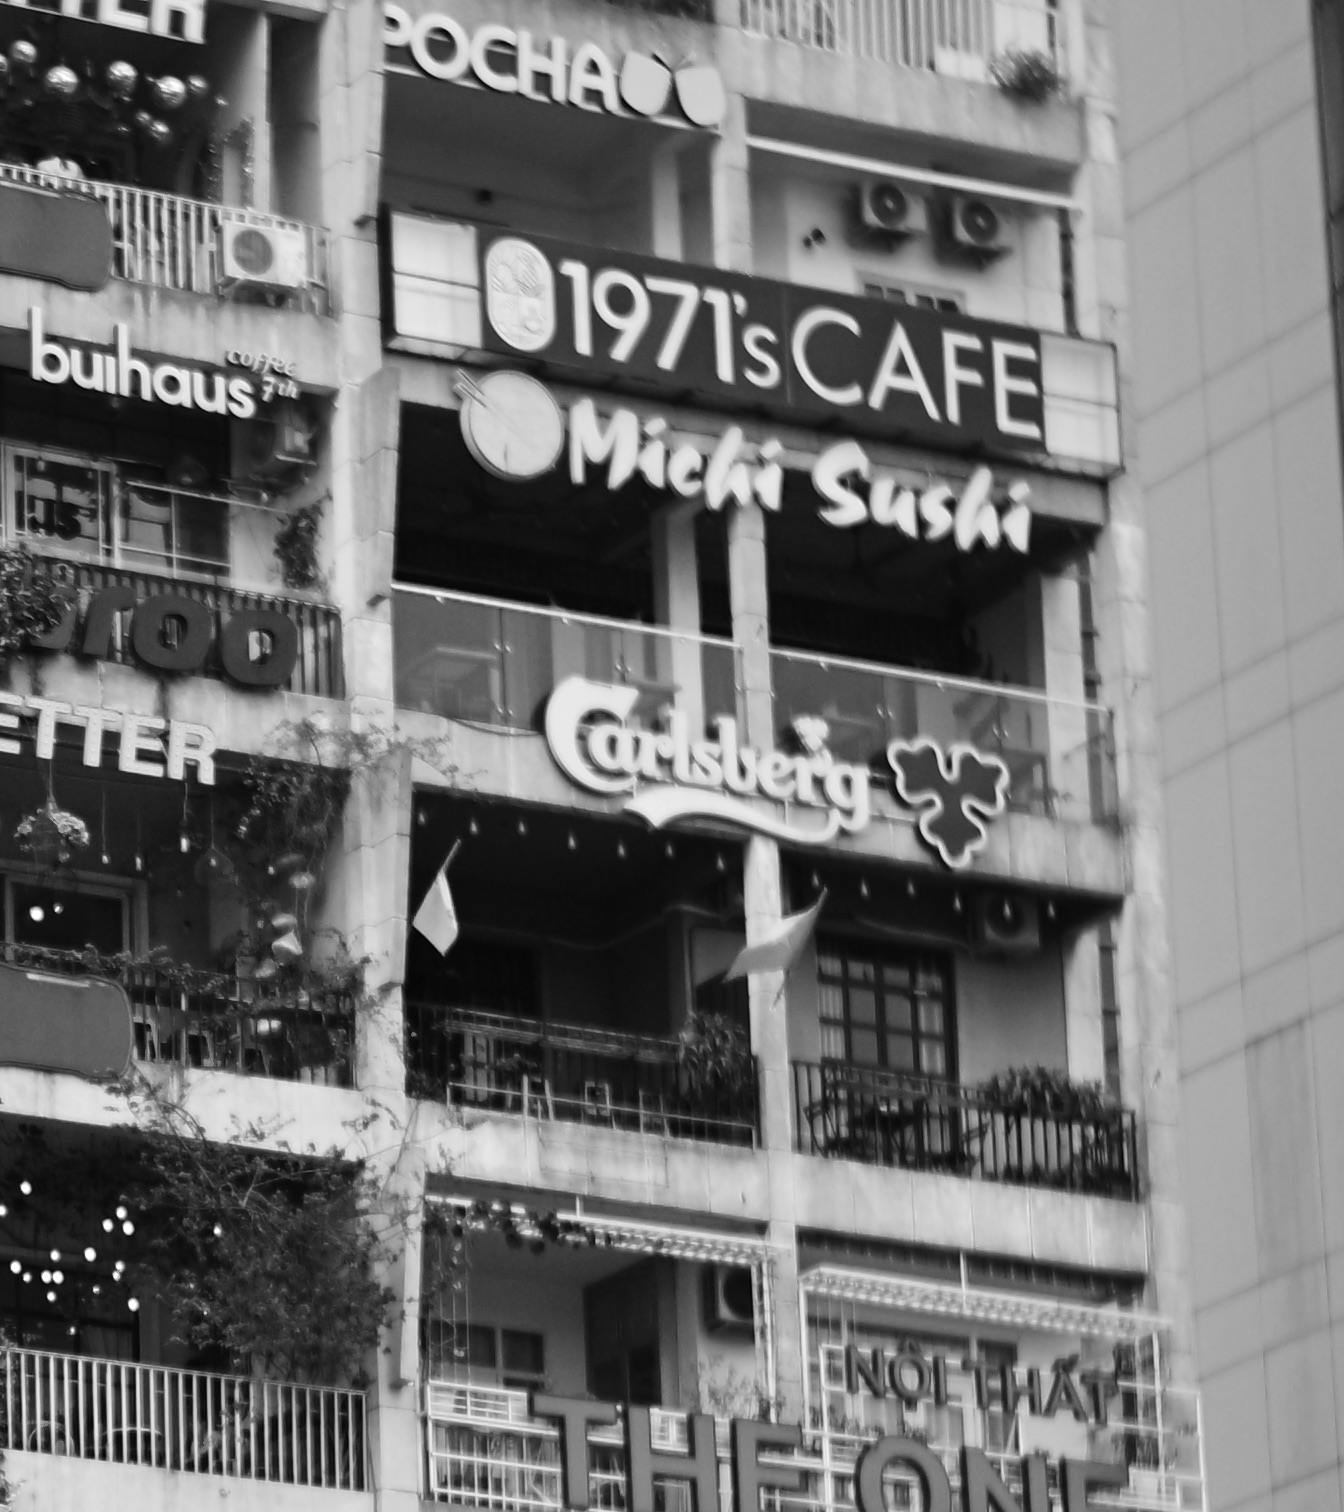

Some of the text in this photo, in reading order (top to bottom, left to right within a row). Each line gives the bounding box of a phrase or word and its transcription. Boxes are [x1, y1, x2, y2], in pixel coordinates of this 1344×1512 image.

[28, 306, 256, 419] buihaus
[226, 349, 298, 377] coffee
[558, 261, 1041, 440] 1971's CAFE
[569, 399, 1033, 554] Michi Sushi
[545, 675, 872, 840] Carlsberg
[845, 1338, 1120, 1428] NỘI THẤT
